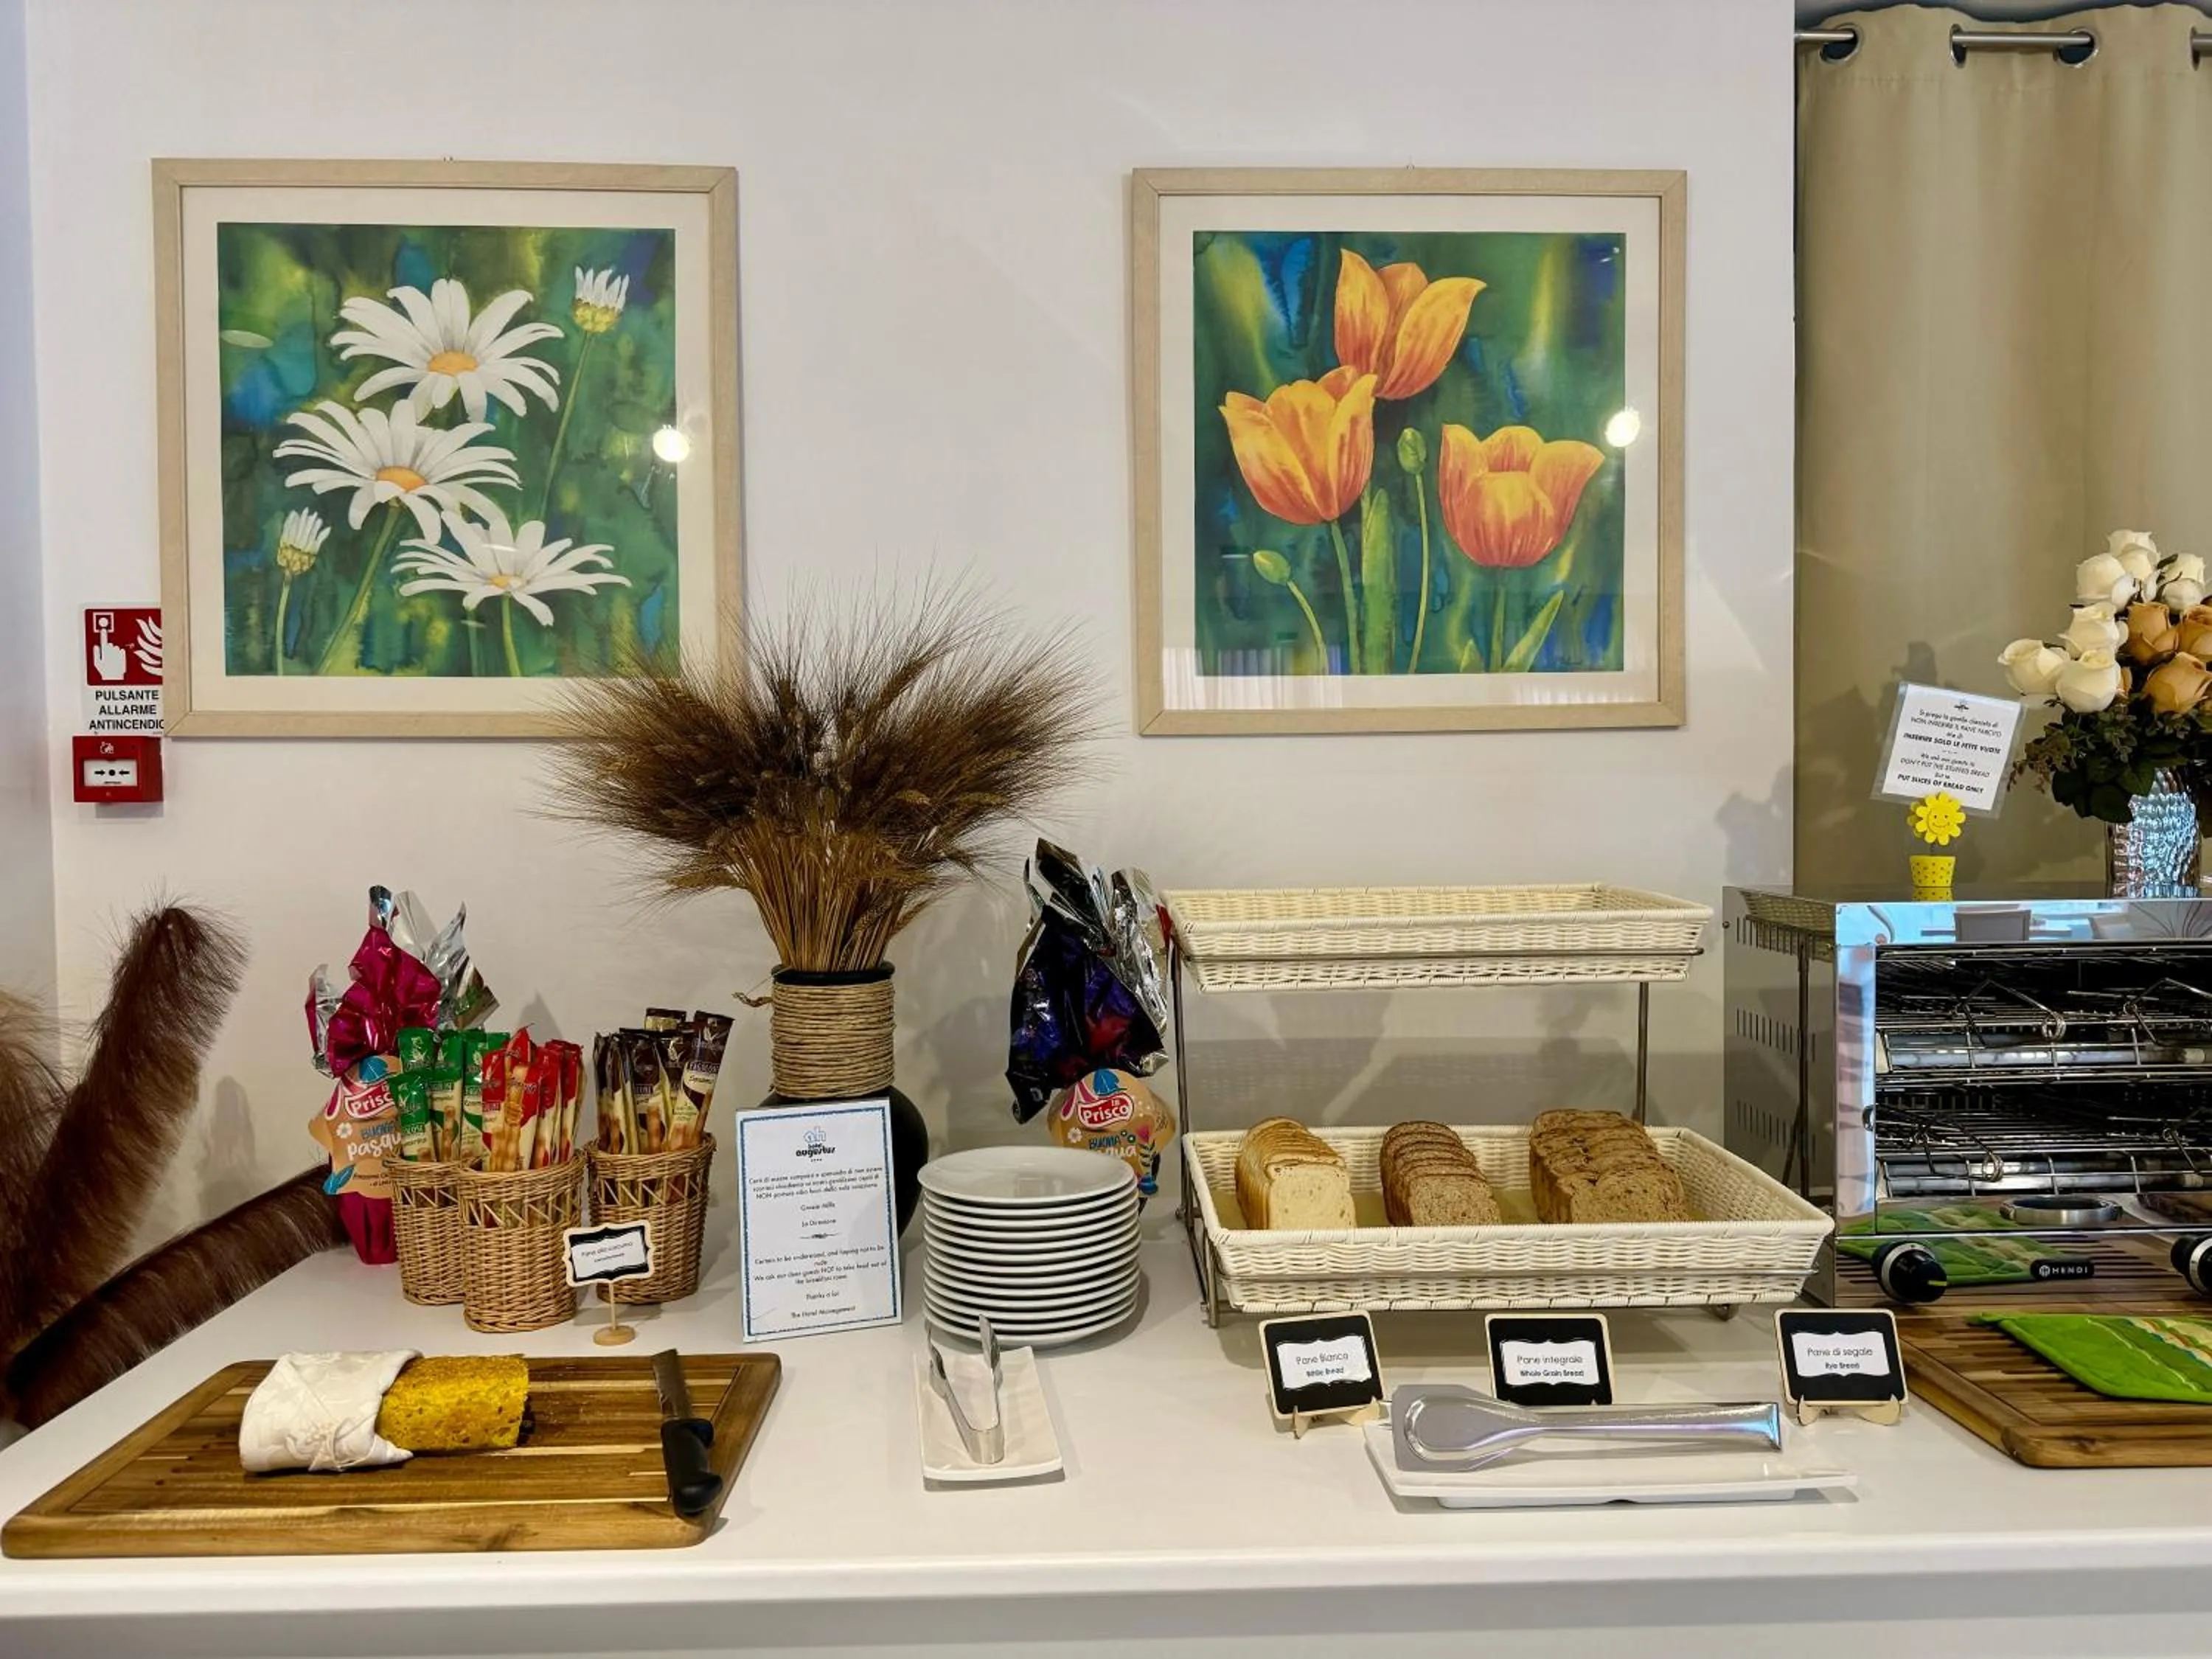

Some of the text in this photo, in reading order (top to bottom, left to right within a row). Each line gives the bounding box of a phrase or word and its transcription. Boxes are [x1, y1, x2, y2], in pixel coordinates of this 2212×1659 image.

[95, 690, 159, 700] PULSANTE
[99, 704, 156, 715] ALLARME
[350, 1093, 393, 1115] Prisc
[1082, 1105, 1129, 1124] Prisco
[1807, 1347, 1873, 1357] Pane di segale
[1295, 1355, 1318, 1365] Pane
[1517, 1355, 1583, 1366] Pane integrale
